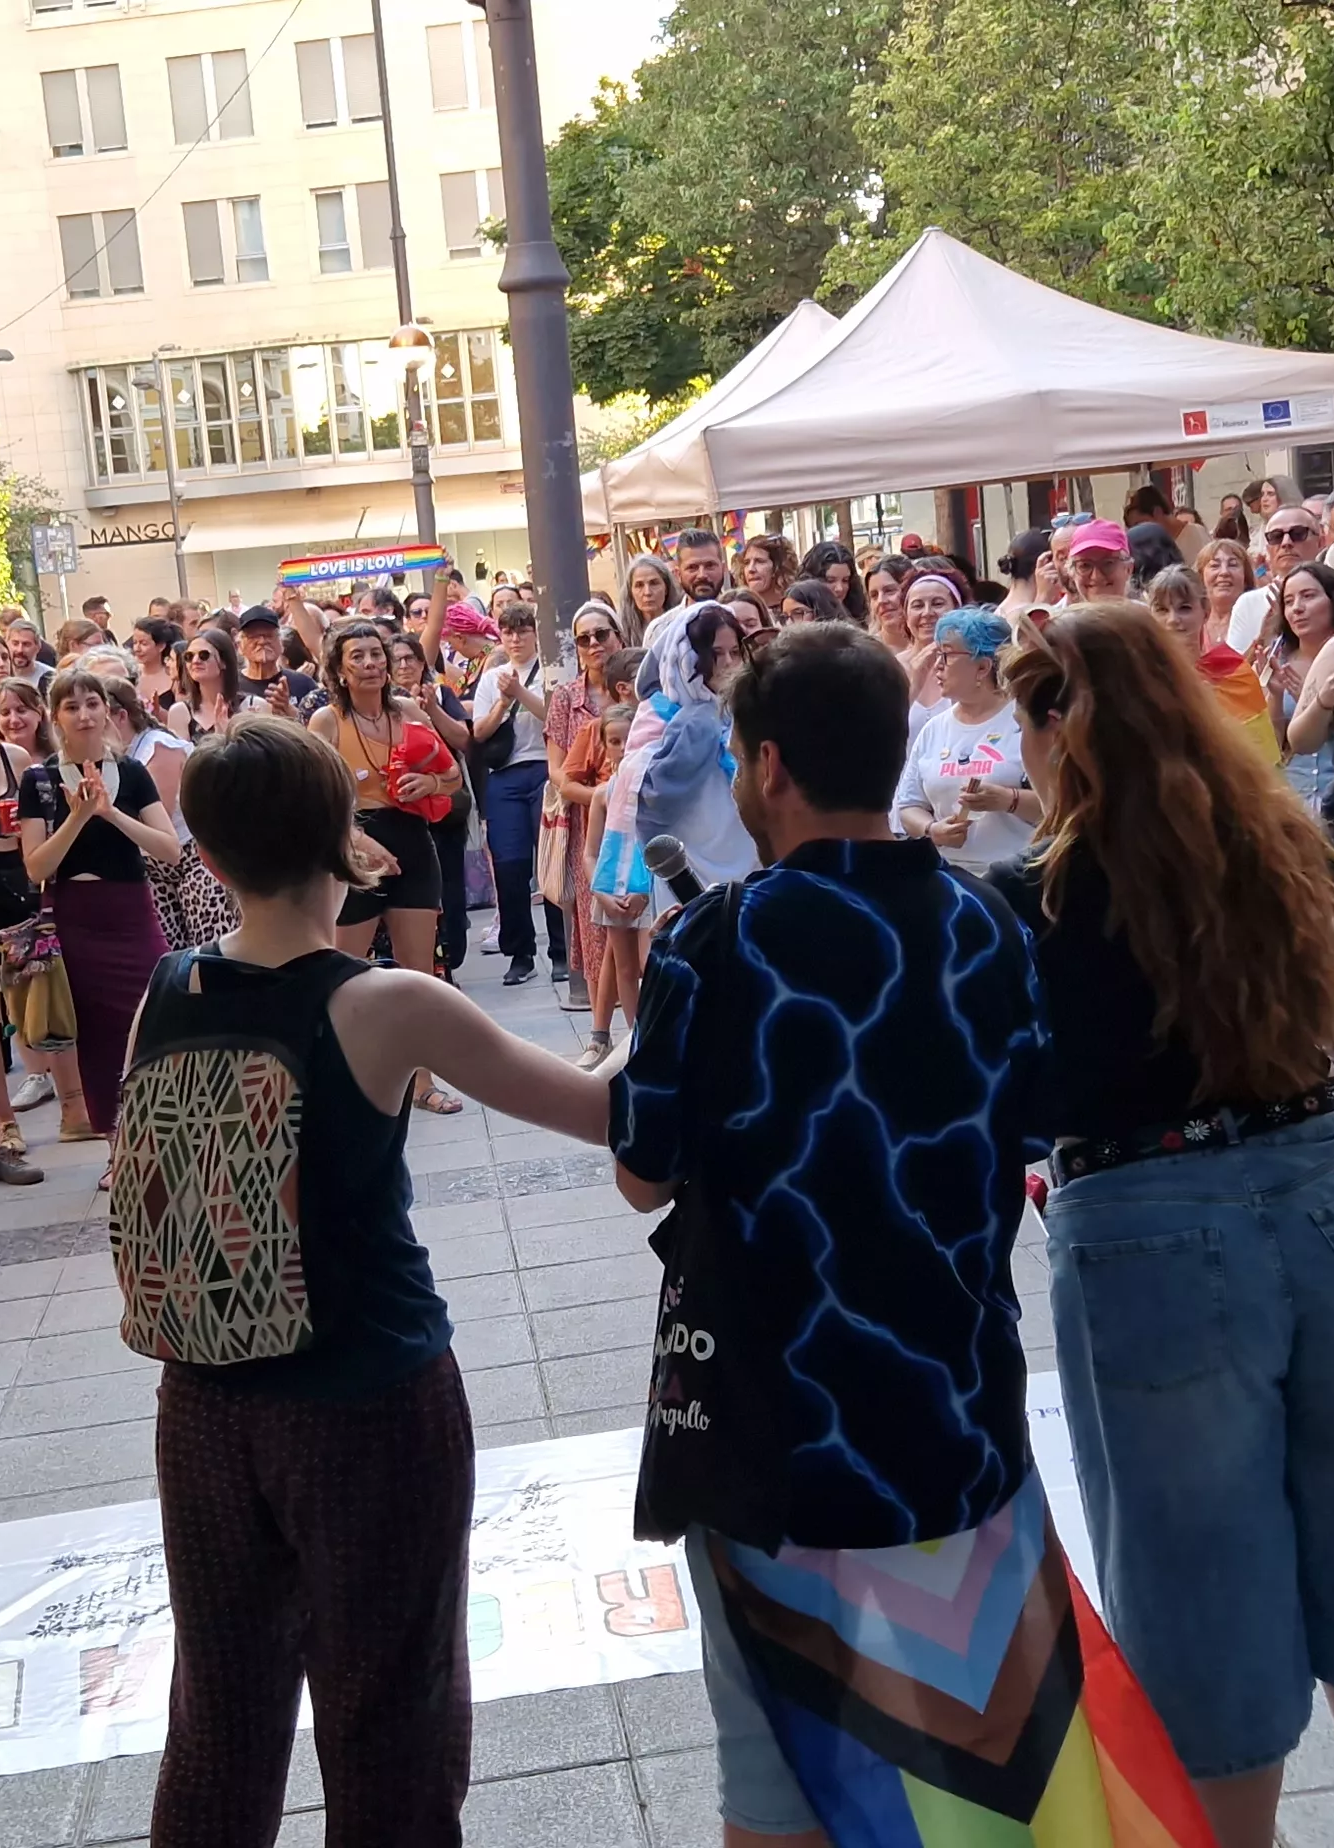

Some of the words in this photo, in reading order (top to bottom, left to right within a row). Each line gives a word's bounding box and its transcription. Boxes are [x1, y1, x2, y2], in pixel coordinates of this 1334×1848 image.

[90, 521, 176, 545] MANGO
[310, 561, 348, 578] LOVE
[351, 558, 364, 573] IS
[367, 553, 405, 571] LOVE
